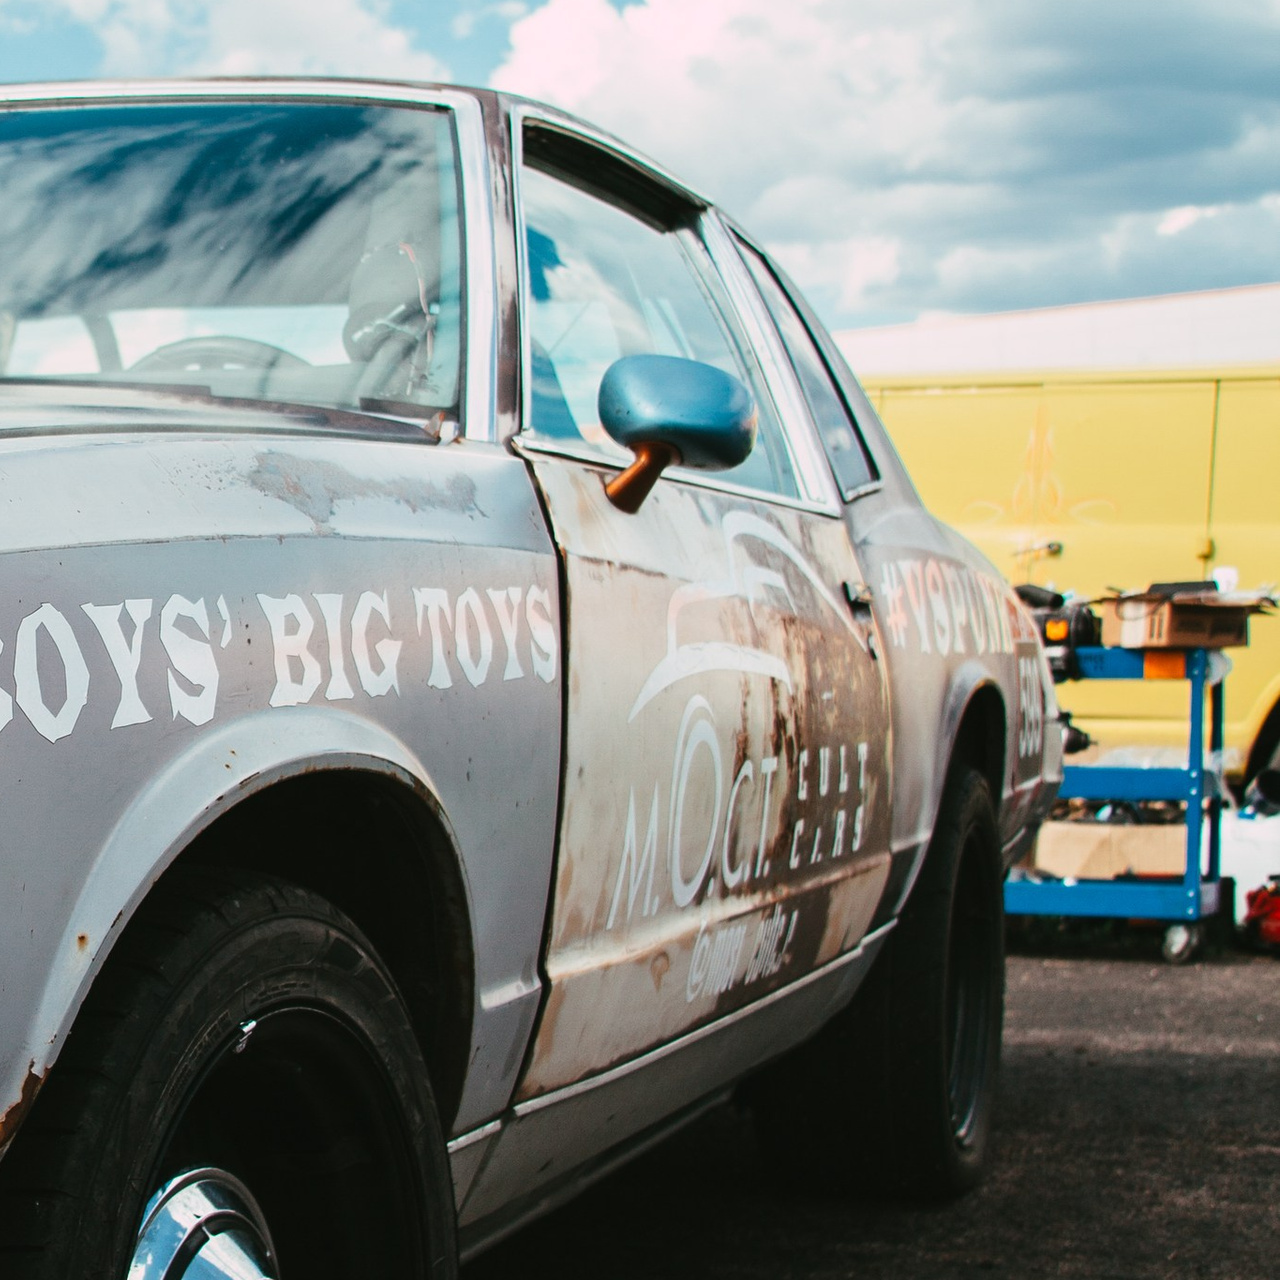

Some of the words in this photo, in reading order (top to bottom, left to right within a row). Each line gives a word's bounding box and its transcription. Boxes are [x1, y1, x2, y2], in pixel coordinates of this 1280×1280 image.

[256, 589, 402, 708] BIG
[412, 584, 558, 689] TOYS
[797, 742, 869, 801] CULT
